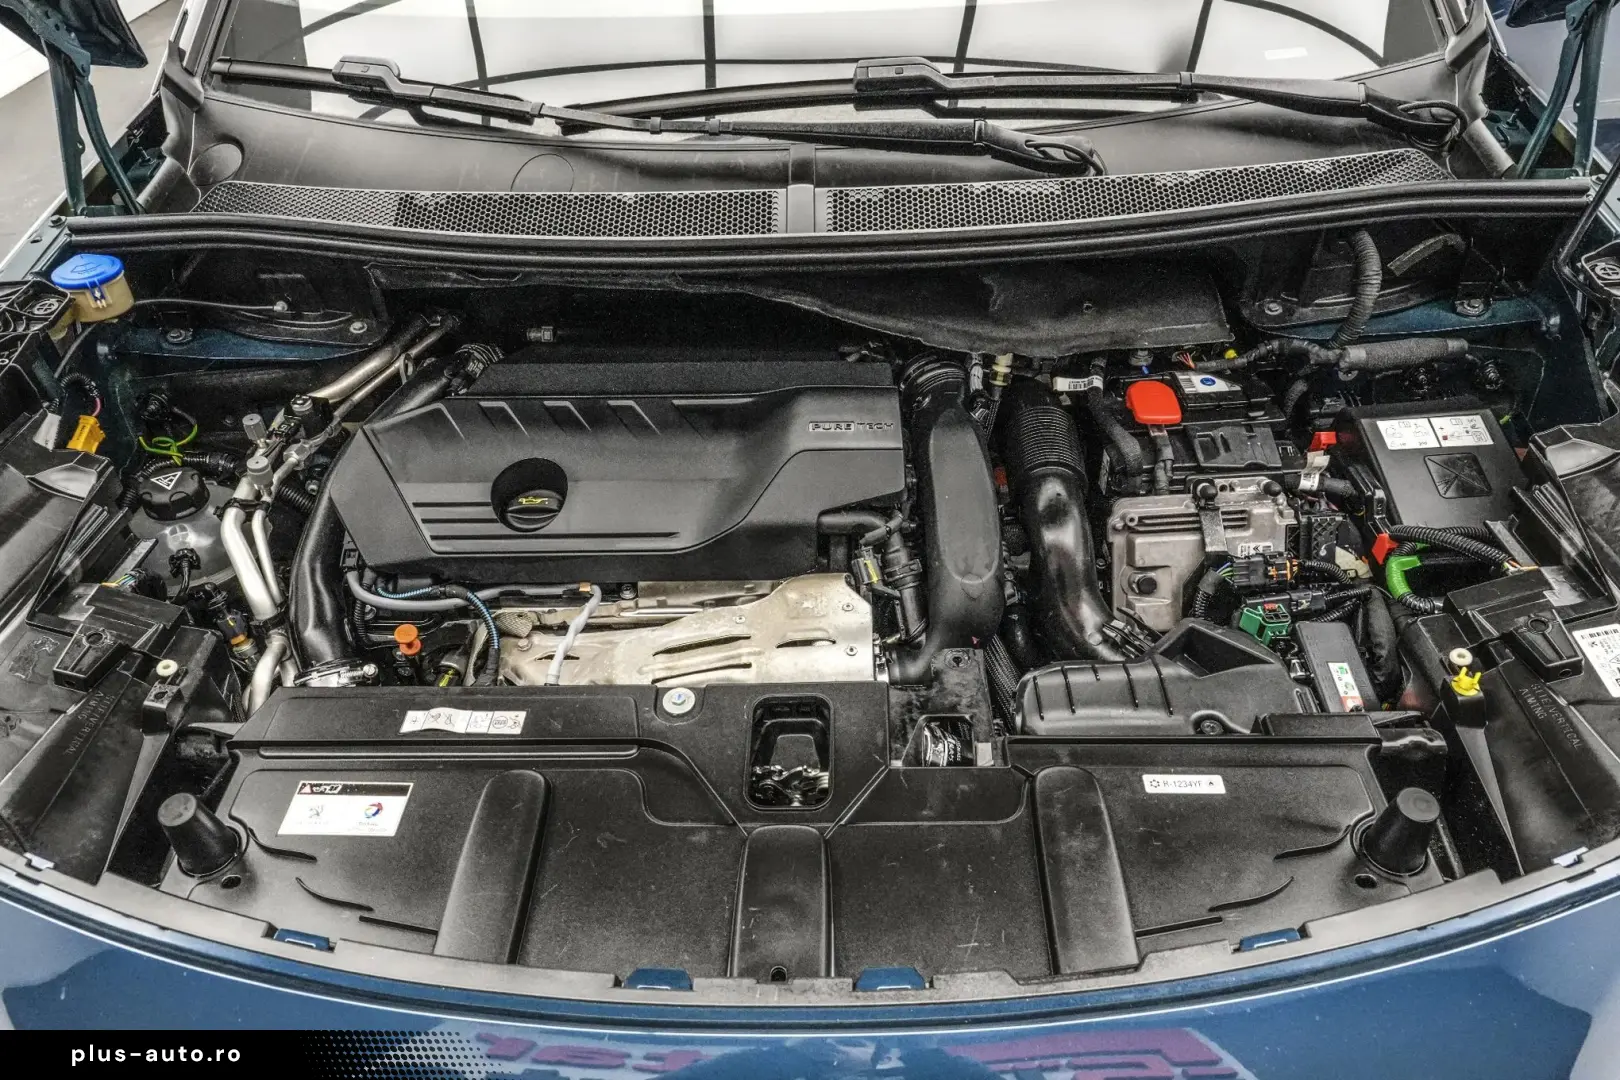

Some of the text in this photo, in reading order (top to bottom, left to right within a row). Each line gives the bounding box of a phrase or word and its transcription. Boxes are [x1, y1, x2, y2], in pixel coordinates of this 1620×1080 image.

[811, 422, 894, 431] PURE TECH
[1519, 687, 1548, 720] AIMING
